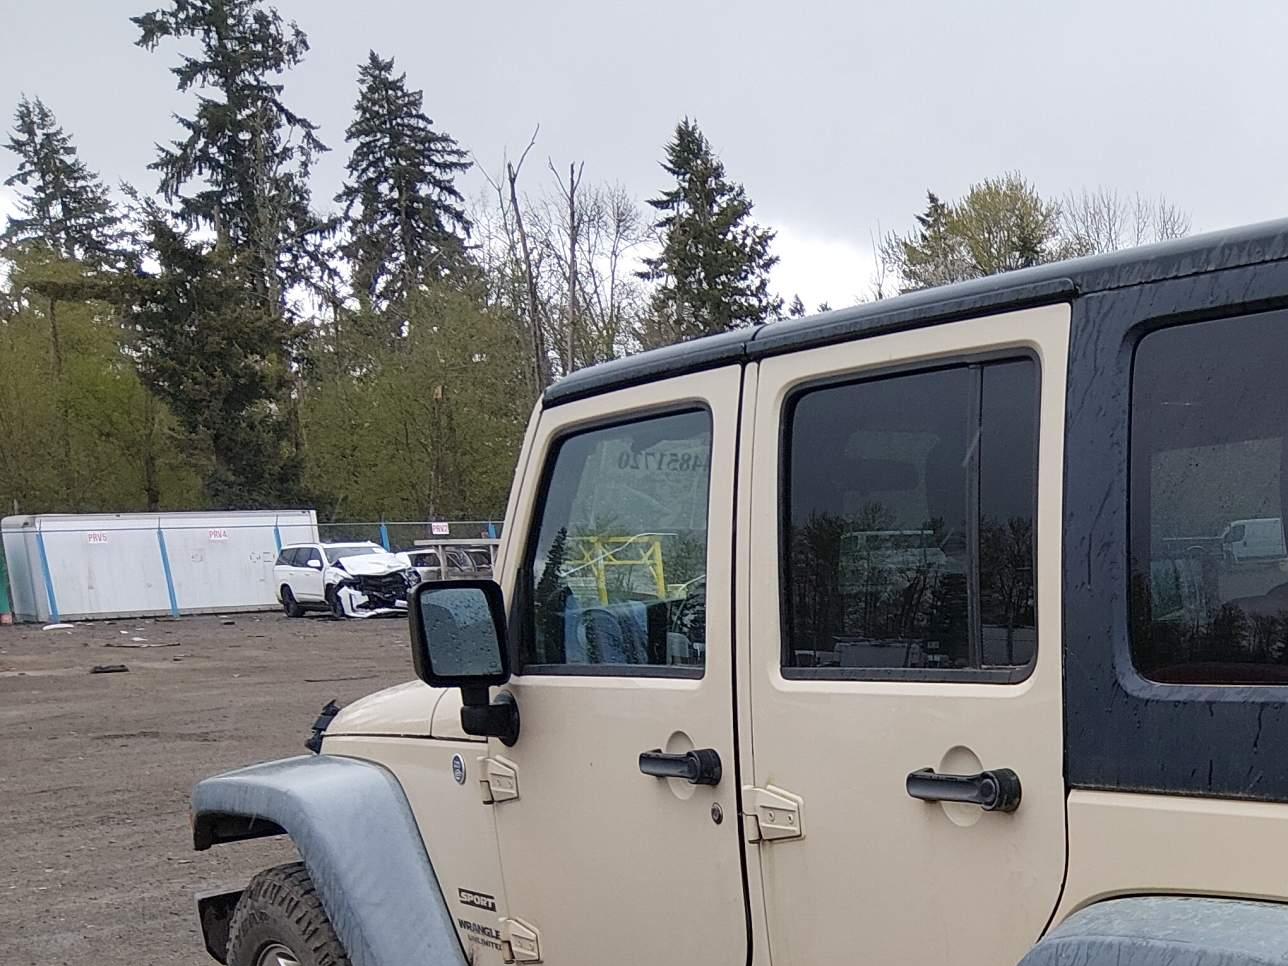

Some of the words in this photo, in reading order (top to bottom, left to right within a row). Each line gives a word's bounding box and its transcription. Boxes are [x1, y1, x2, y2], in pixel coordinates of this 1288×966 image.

[88, 533, 108, 542] PRV5
[208, 530, 229, 539] PRV4
[459, 890, 496, 910] SPORT
[457, 918, 501, 940] WRANGLE
[467, 935, 502, 951] UNLIMITE
